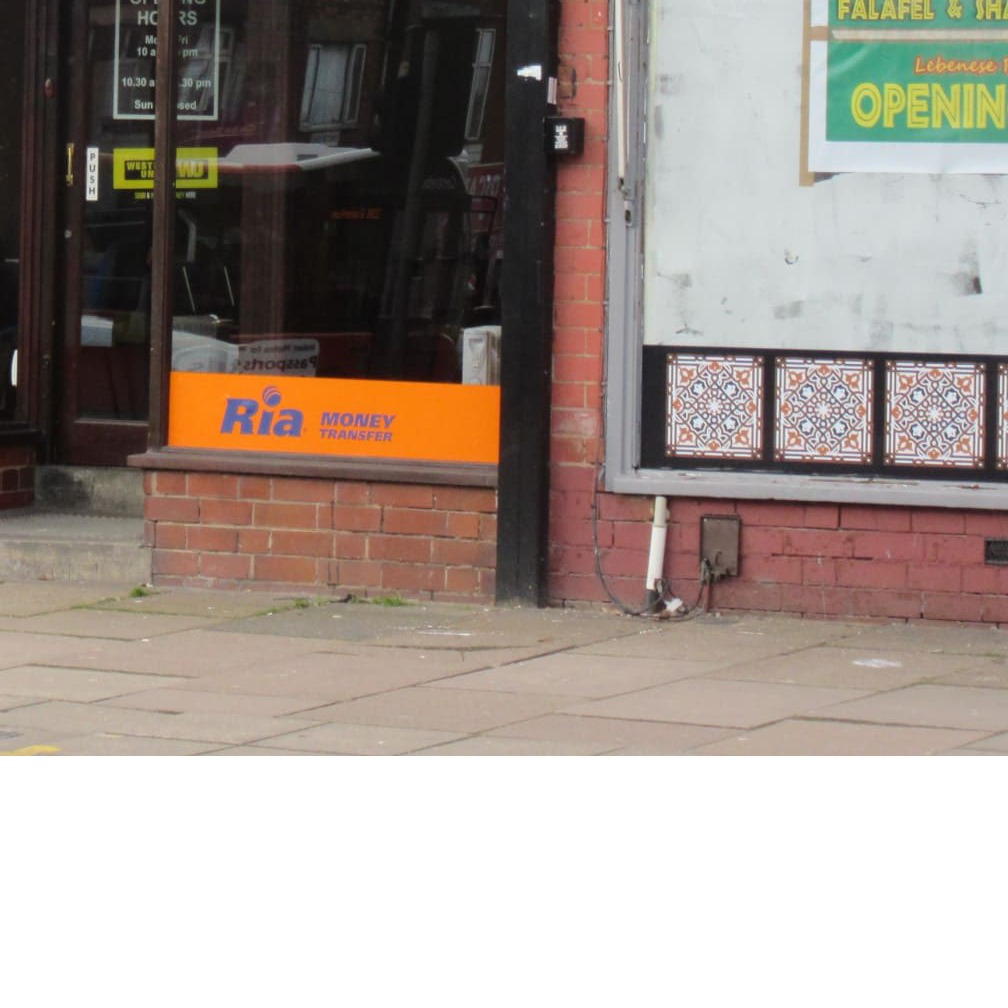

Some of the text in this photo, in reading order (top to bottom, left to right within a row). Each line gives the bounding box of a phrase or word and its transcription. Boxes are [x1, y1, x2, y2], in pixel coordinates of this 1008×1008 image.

[915, 56, 997, 74] Lebenese
[134, 99, 153, 109] Sun
[220, 386, 304, 438] Ria
[320, 412, 396, 428] MONEY
[320, 428, 393, 442] TRANSFER
